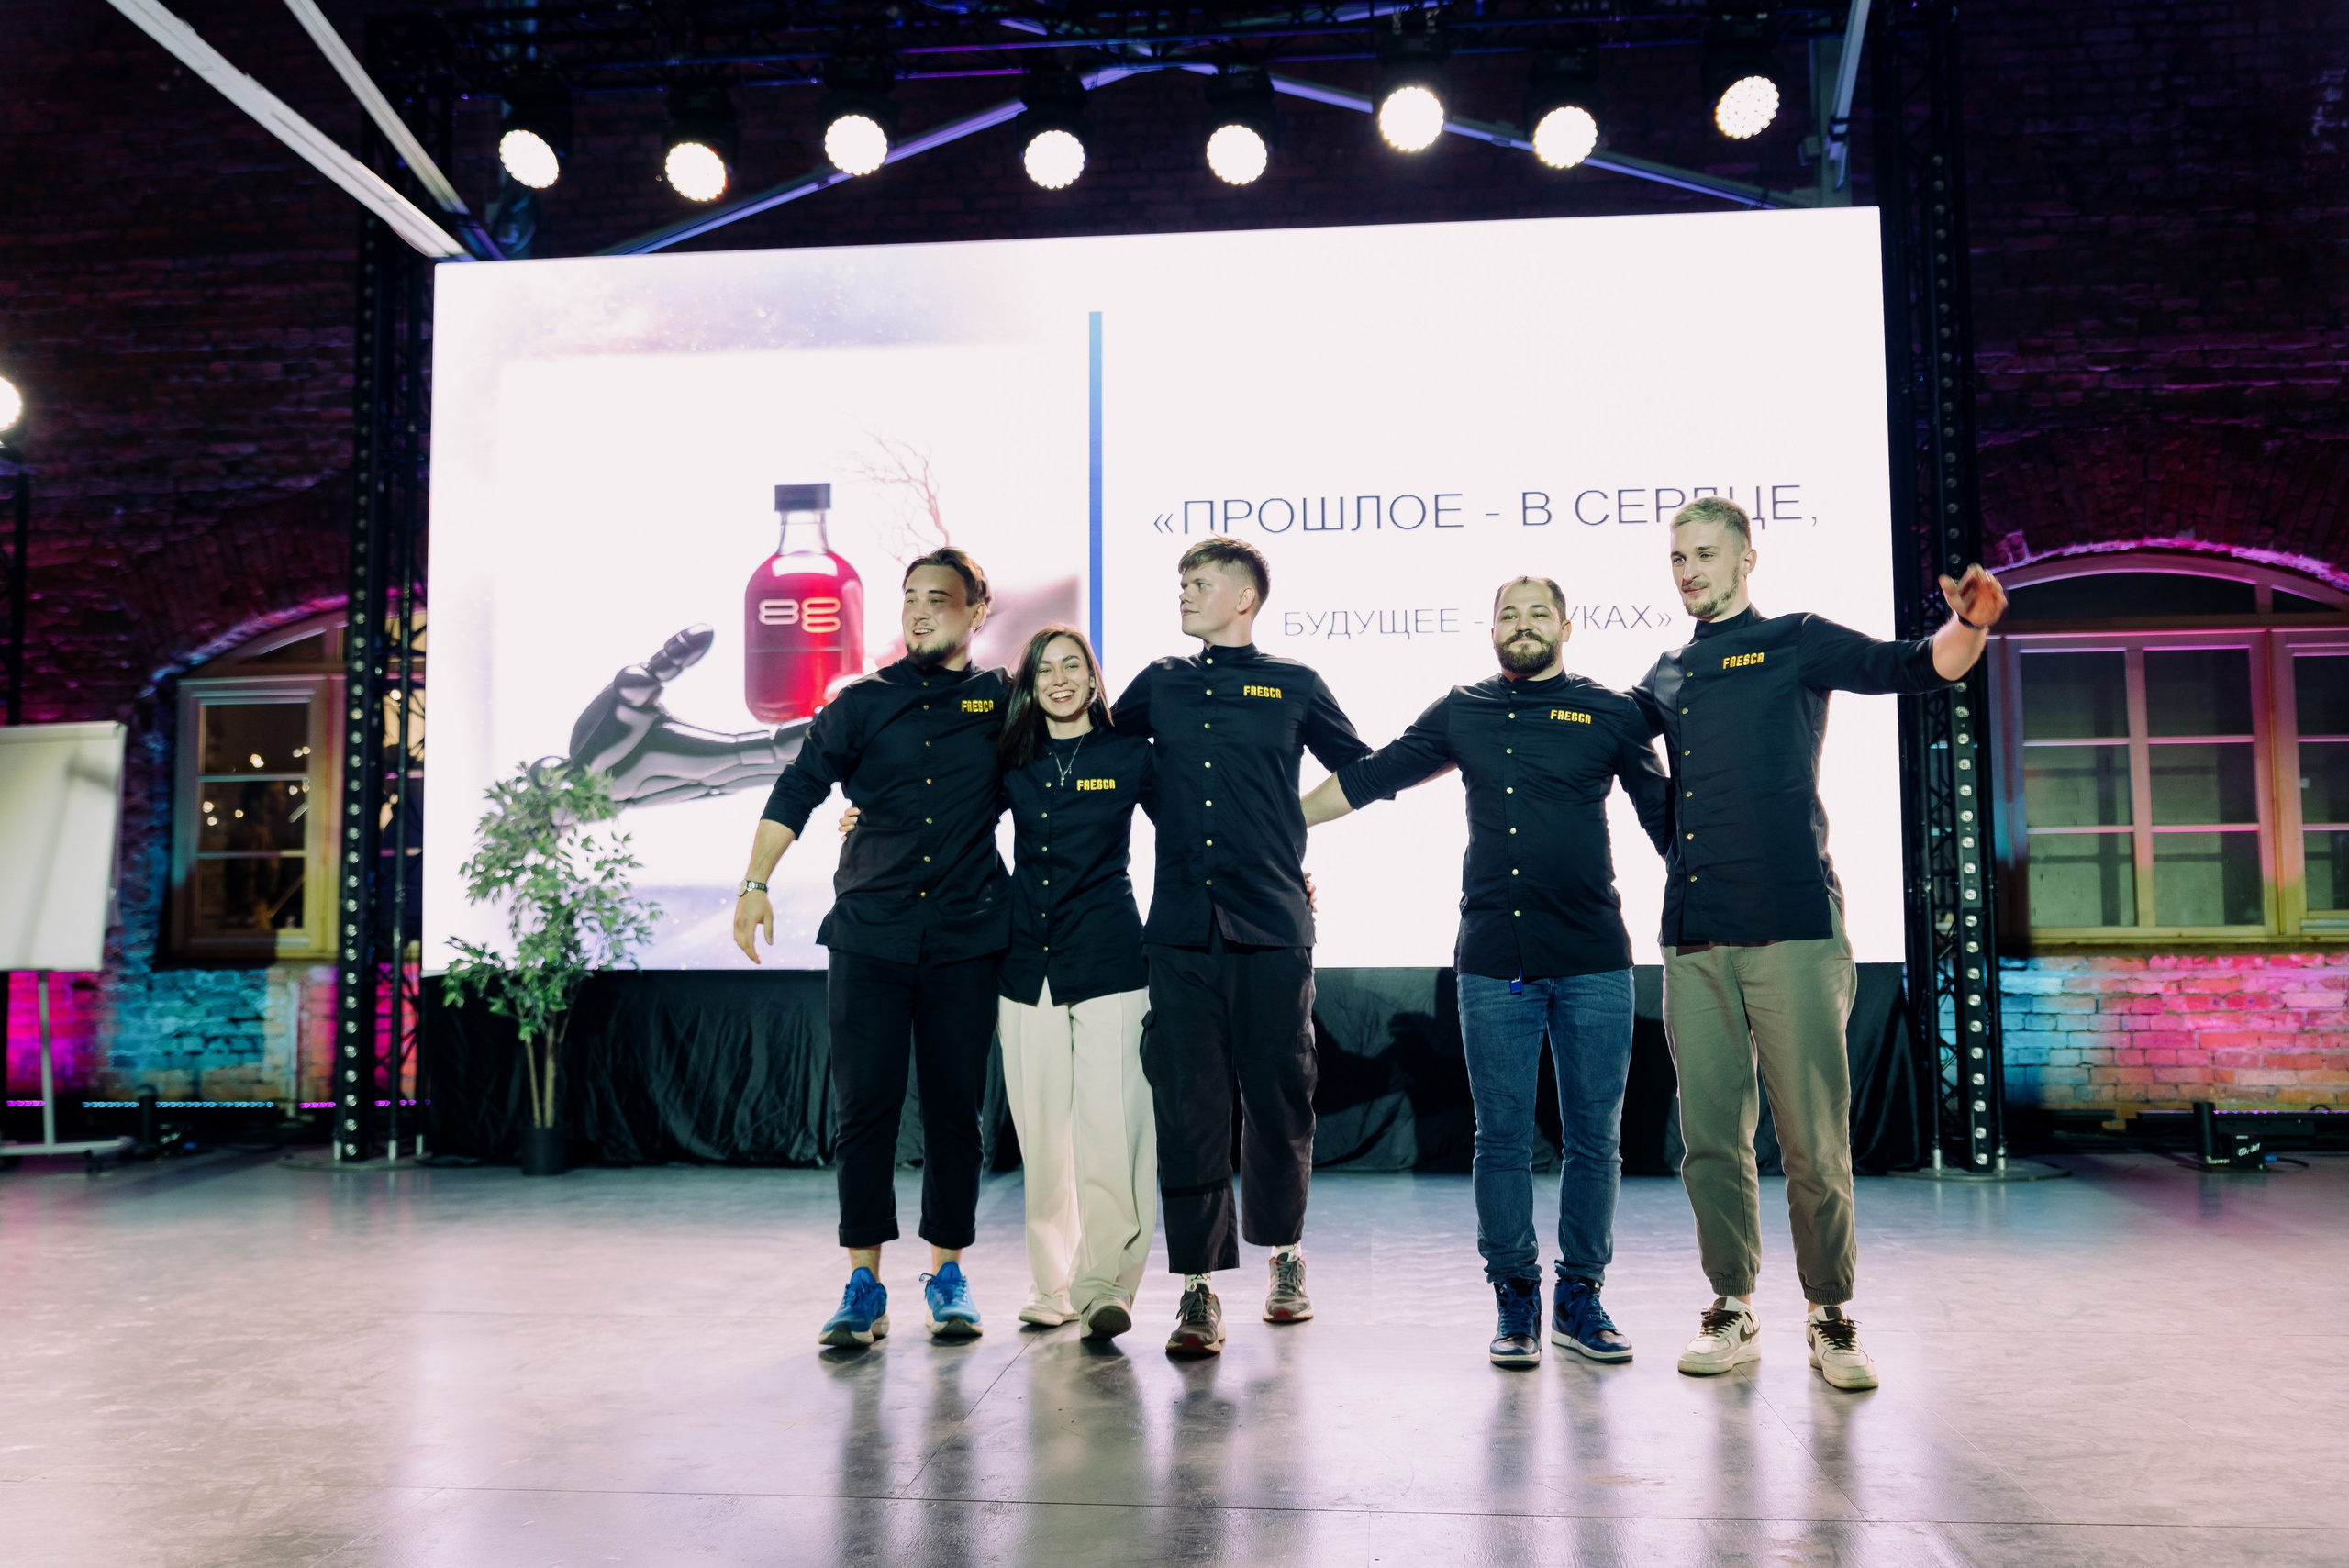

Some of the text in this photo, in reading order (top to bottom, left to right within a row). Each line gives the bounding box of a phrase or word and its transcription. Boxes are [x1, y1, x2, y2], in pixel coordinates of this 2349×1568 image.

[1153, 494, 1464, 534] «ПРОШЛОЕ
[1521, 491, 1553, 527] В
[1284, 608, 1460, 639] БУДУЩЕЕ
[1722, 652, 1765, 670] FRESCA
[1243, 685, 1283, 699] FRESCA
[961, 699, 994, 713] FRESCA
[1550, 709, 1592, 724] FRESCA
[1076, 778, 1116, 791] FRESCA
